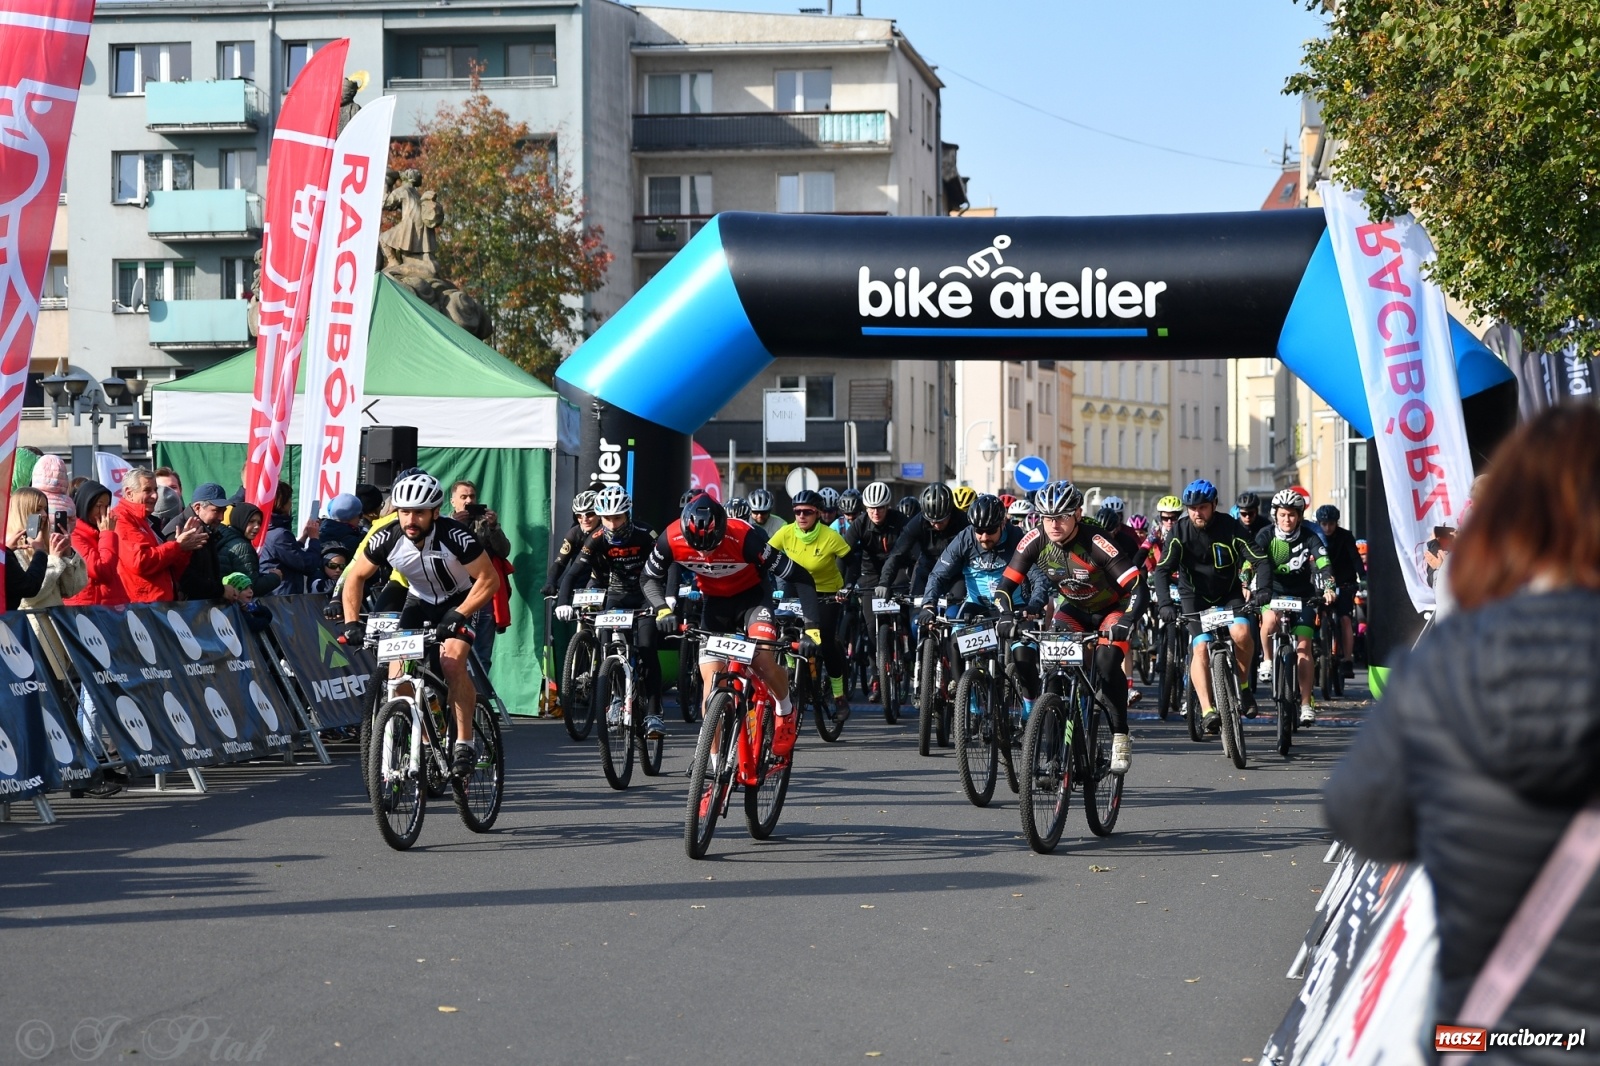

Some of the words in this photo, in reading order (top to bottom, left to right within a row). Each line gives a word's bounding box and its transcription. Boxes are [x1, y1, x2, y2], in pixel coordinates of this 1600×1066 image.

[858, 266, 973, 318] bike
[989, 266, 1167, 318] atelier
[319, 153, 370, 503] RACIBÓRZ
[373, 621, 399, 630] 1873
[602, 615, 627, 623] 3290
[386, 639, 416, 652] 2676
[716, 639, 747, 653] 1472
[964, 635, 991, 649] 2254
[1047, 645, 1076, 657] 1236
